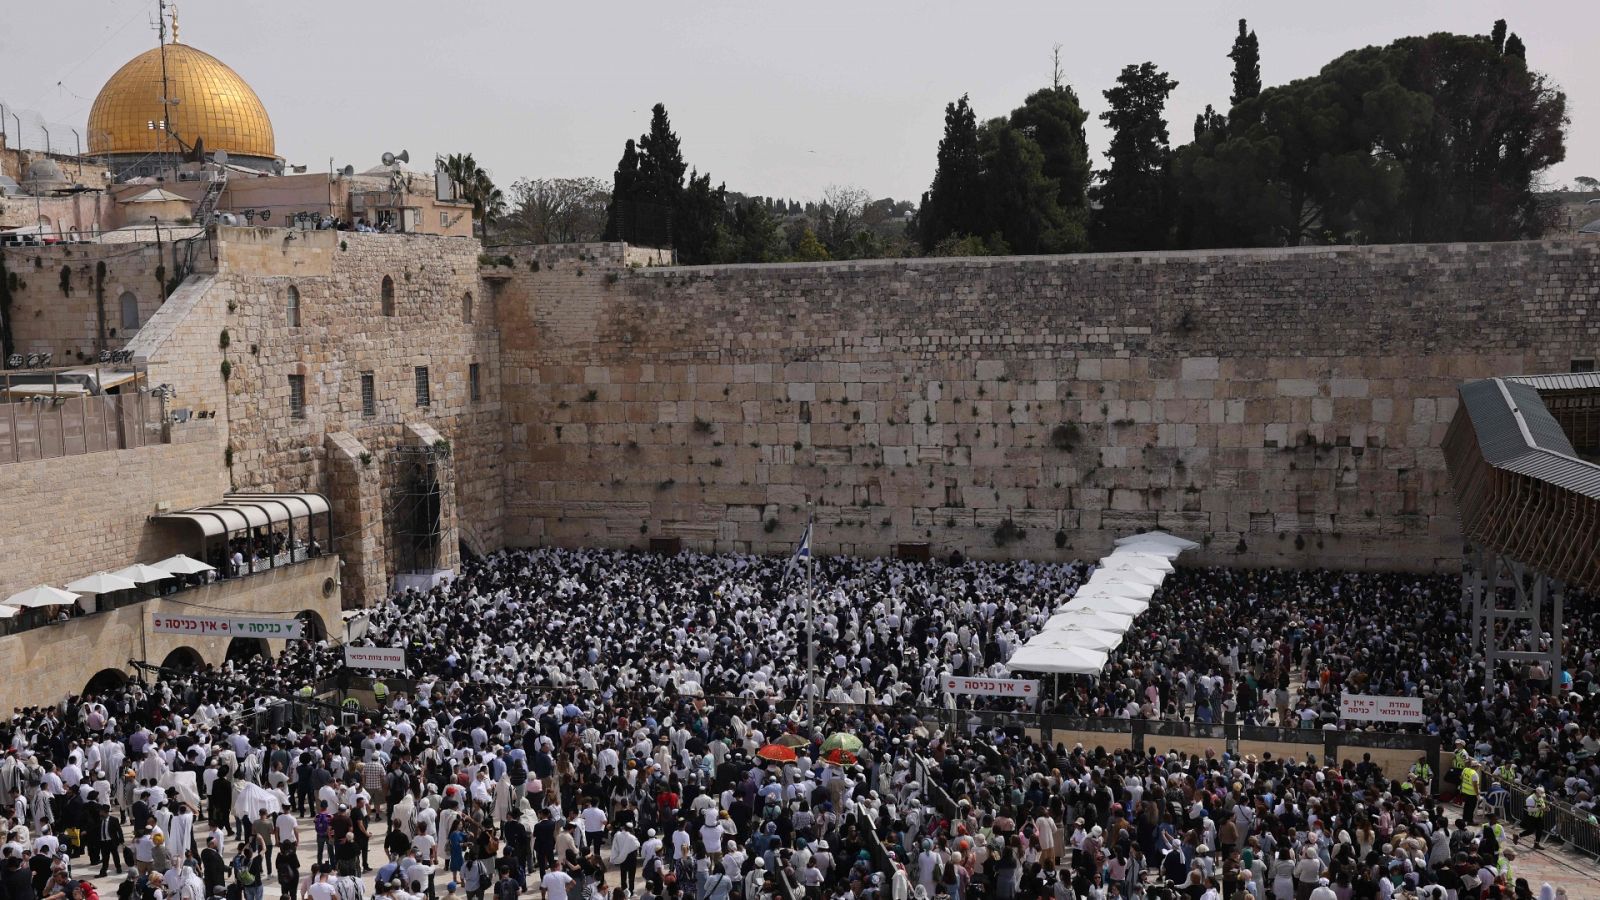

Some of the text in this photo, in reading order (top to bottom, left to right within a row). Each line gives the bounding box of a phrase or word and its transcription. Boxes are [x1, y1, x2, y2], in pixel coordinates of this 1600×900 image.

[166, 618, 217, 632] אין כניסה
[249, 623, 281, 632] כניסה
[964, 681, 1015, 693] אין כניסה
